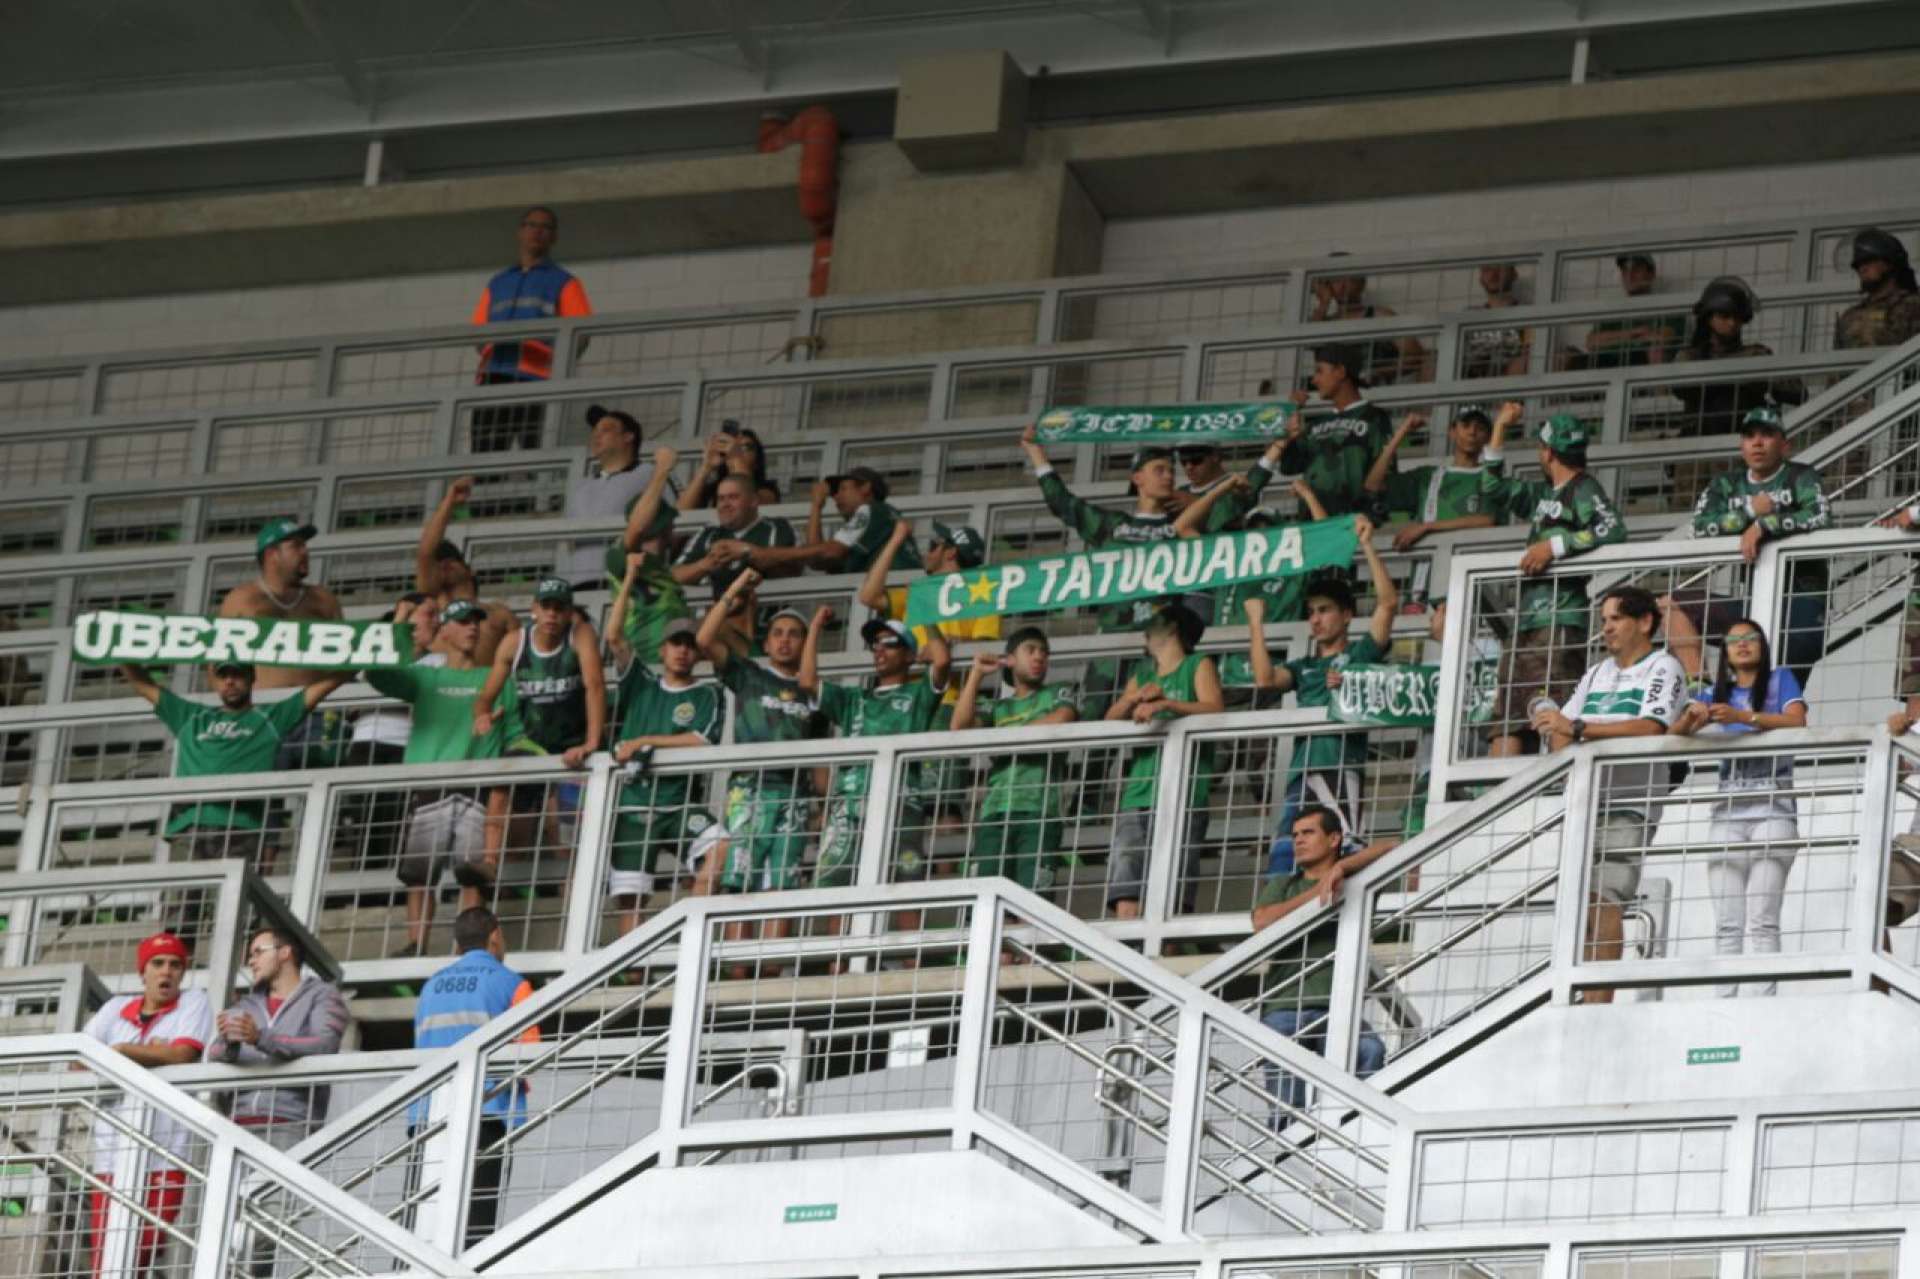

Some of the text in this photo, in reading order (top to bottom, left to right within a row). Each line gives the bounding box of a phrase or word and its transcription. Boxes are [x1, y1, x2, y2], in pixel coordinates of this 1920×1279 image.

[1037, 527, 1304, 606] TATUQUARA
[74, 610, 400, 664] UBERABA
[434, 976, 478, 994] 0688
